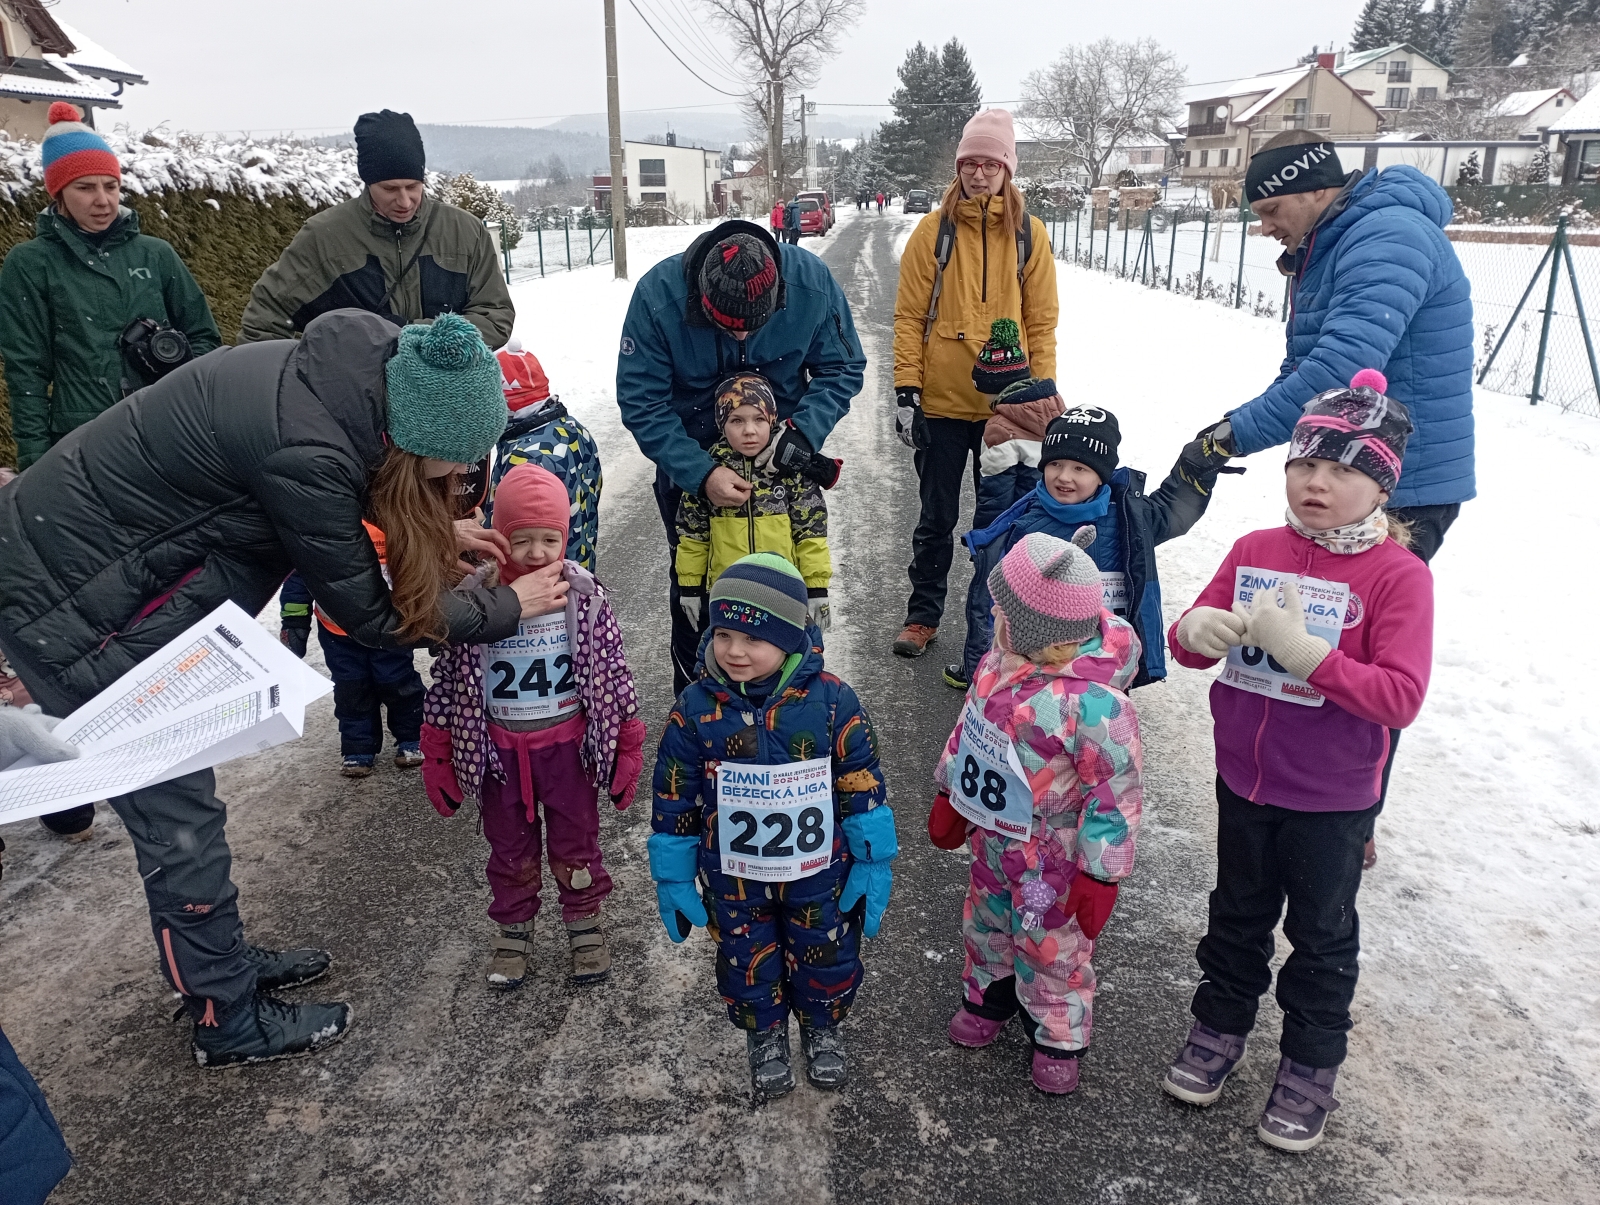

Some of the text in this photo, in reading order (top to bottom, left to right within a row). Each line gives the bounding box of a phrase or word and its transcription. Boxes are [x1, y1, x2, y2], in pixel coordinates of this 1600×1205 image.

[1257, 143, 1331, 197] INOVIK
[719, 602, 769, 622] MONSTER
[723, 611, 761, 626] WORLD
[1304, 603, 1338, 618] IGA
[215, 624, 243, 648] MARATON
[490, 654, 576, 699] 242
[722, 769, 770, 786] ZIMNÍ
[773, 770, 827, 785] 2024-2025
[961, 754, 1007, 811] 88
[722, 781, 828, 800] BĚŽECKÁ LIGA
[728, 806, 826, 857] 228
